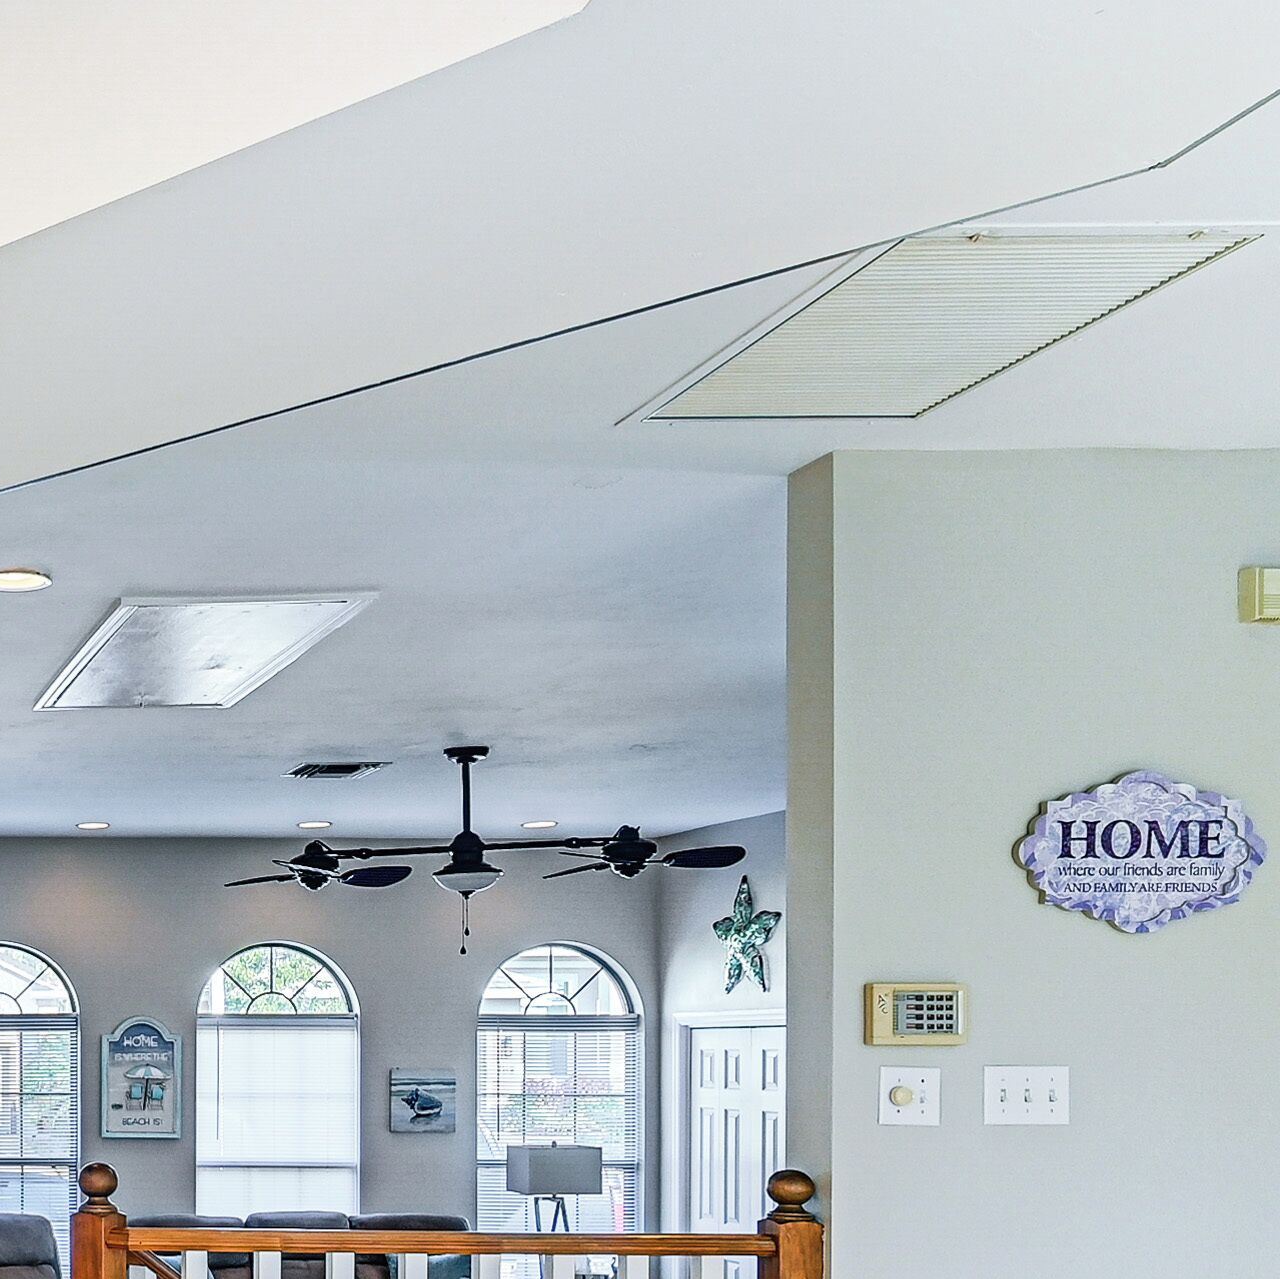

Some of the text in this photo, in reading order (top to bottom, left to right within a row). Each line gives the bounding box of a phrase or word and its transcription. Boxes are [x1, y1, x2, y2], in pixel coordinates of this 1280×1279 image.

[1057, 819, 1225, 859] HOME
[1058, 863, 1225, 881] where our friends are family
[1063, 882, 1218, 893] AND FAMILY ARE FRIENDS
[123, 1034, 159, 1048] HOME
[122, 1117, 150, 1126] BEACH
